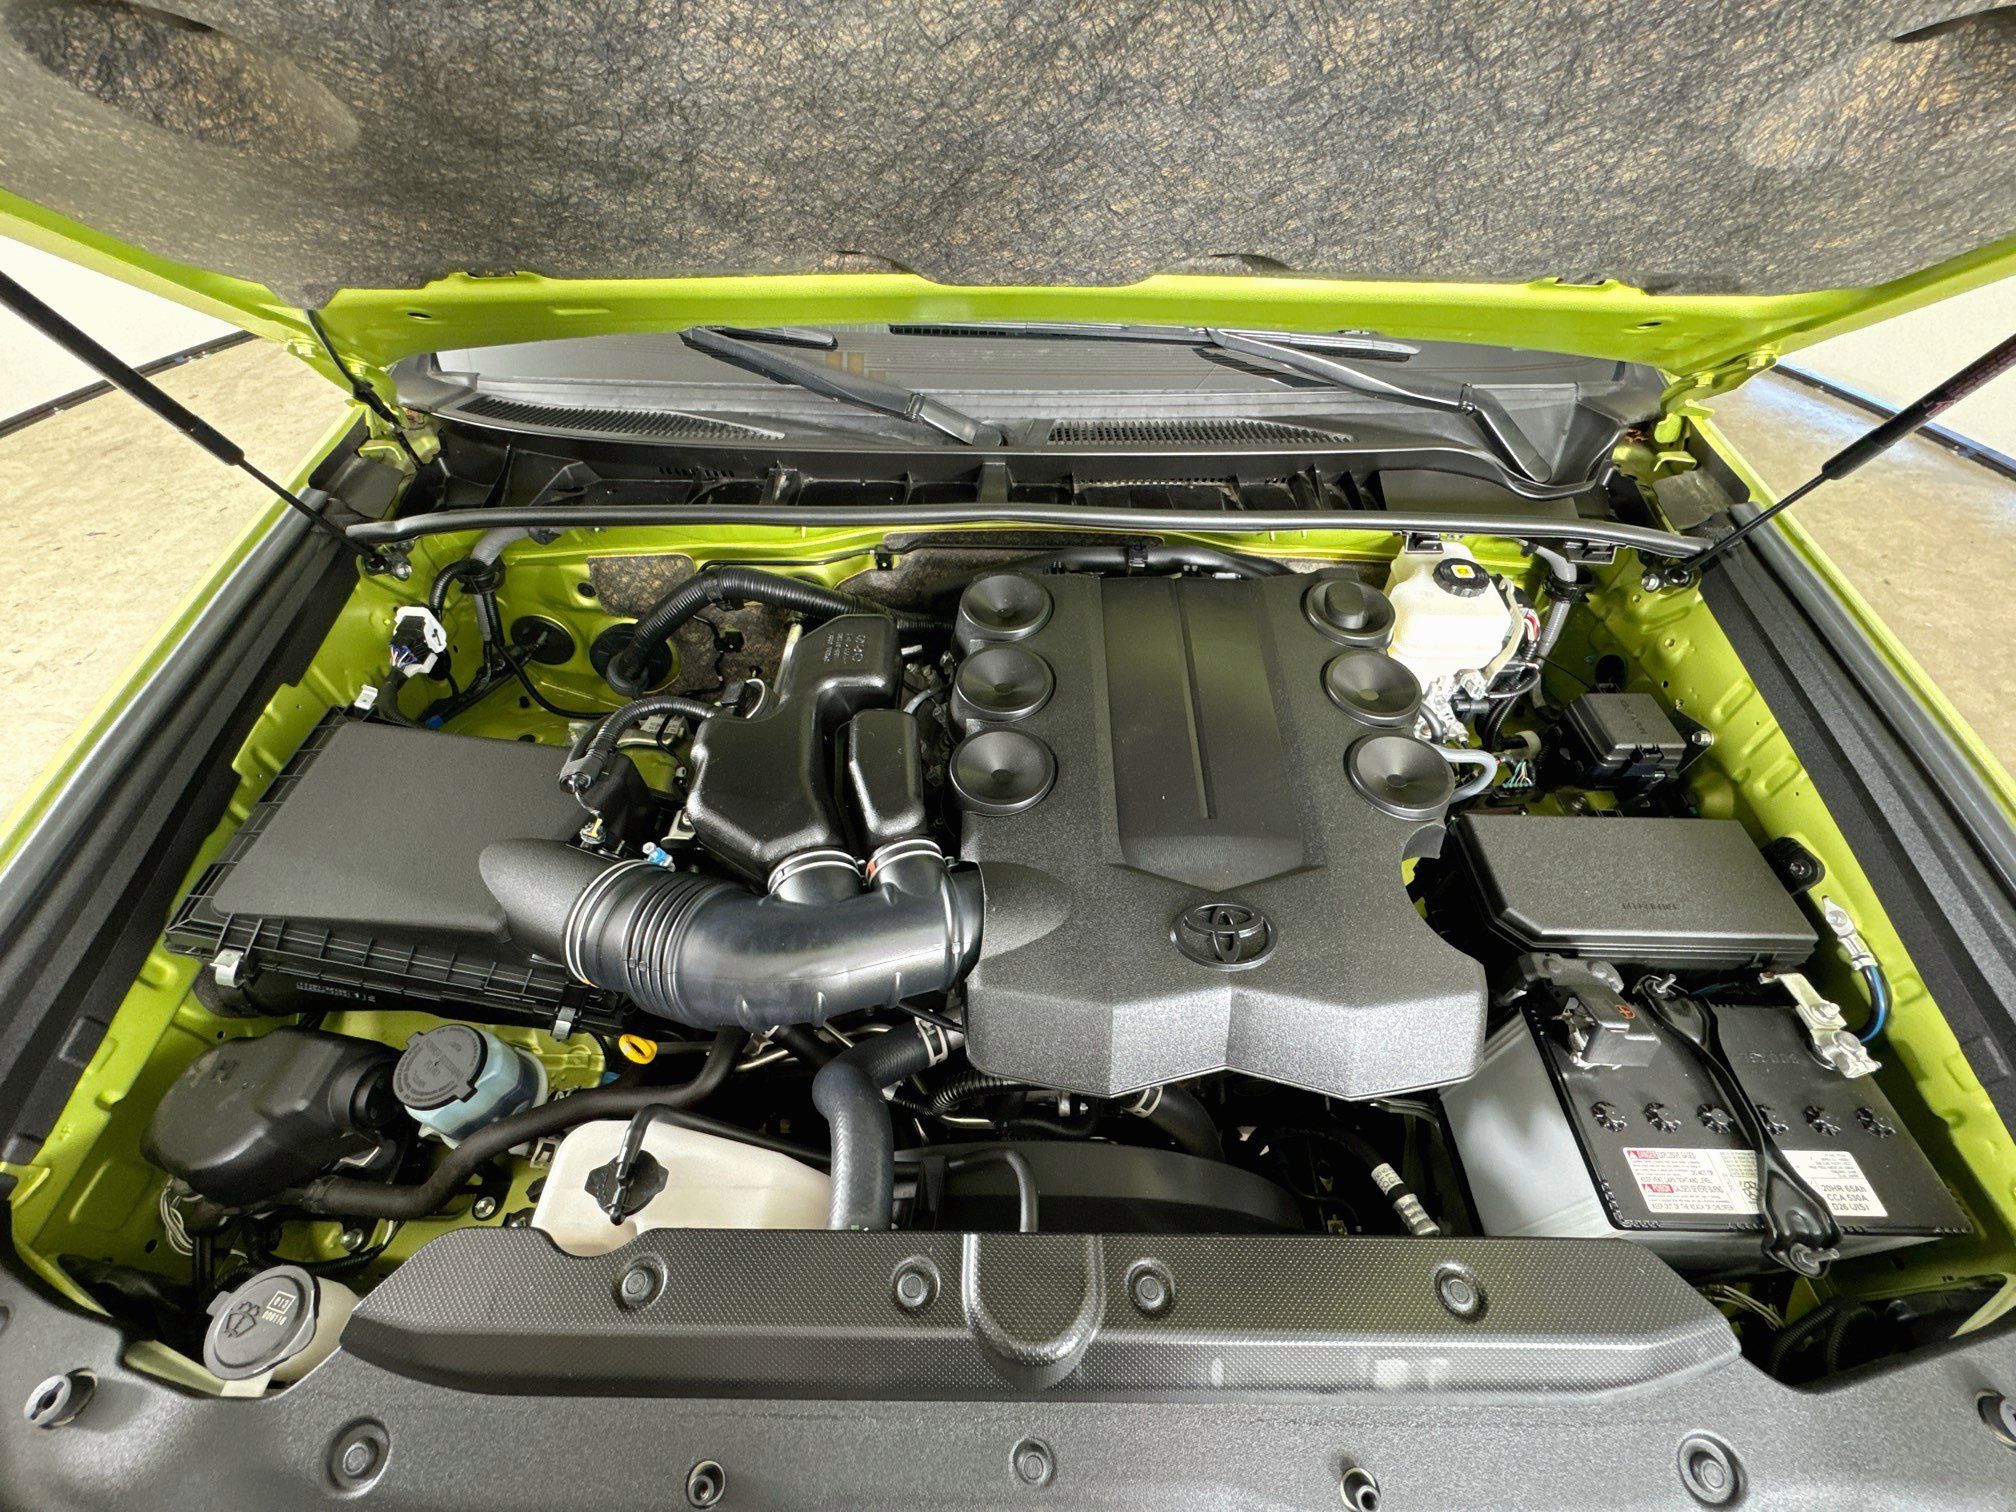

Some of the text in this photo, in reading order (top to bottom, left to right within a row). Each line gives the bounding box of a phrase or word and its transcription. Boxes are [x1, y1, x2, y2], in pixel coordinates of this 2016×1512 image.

[1821, 1184, 1867, 1193] 20HR 65Ah
[1827, 1193, 1869, 1202] CCA 530A
[1832, 1203, 1849, 1211] D26
